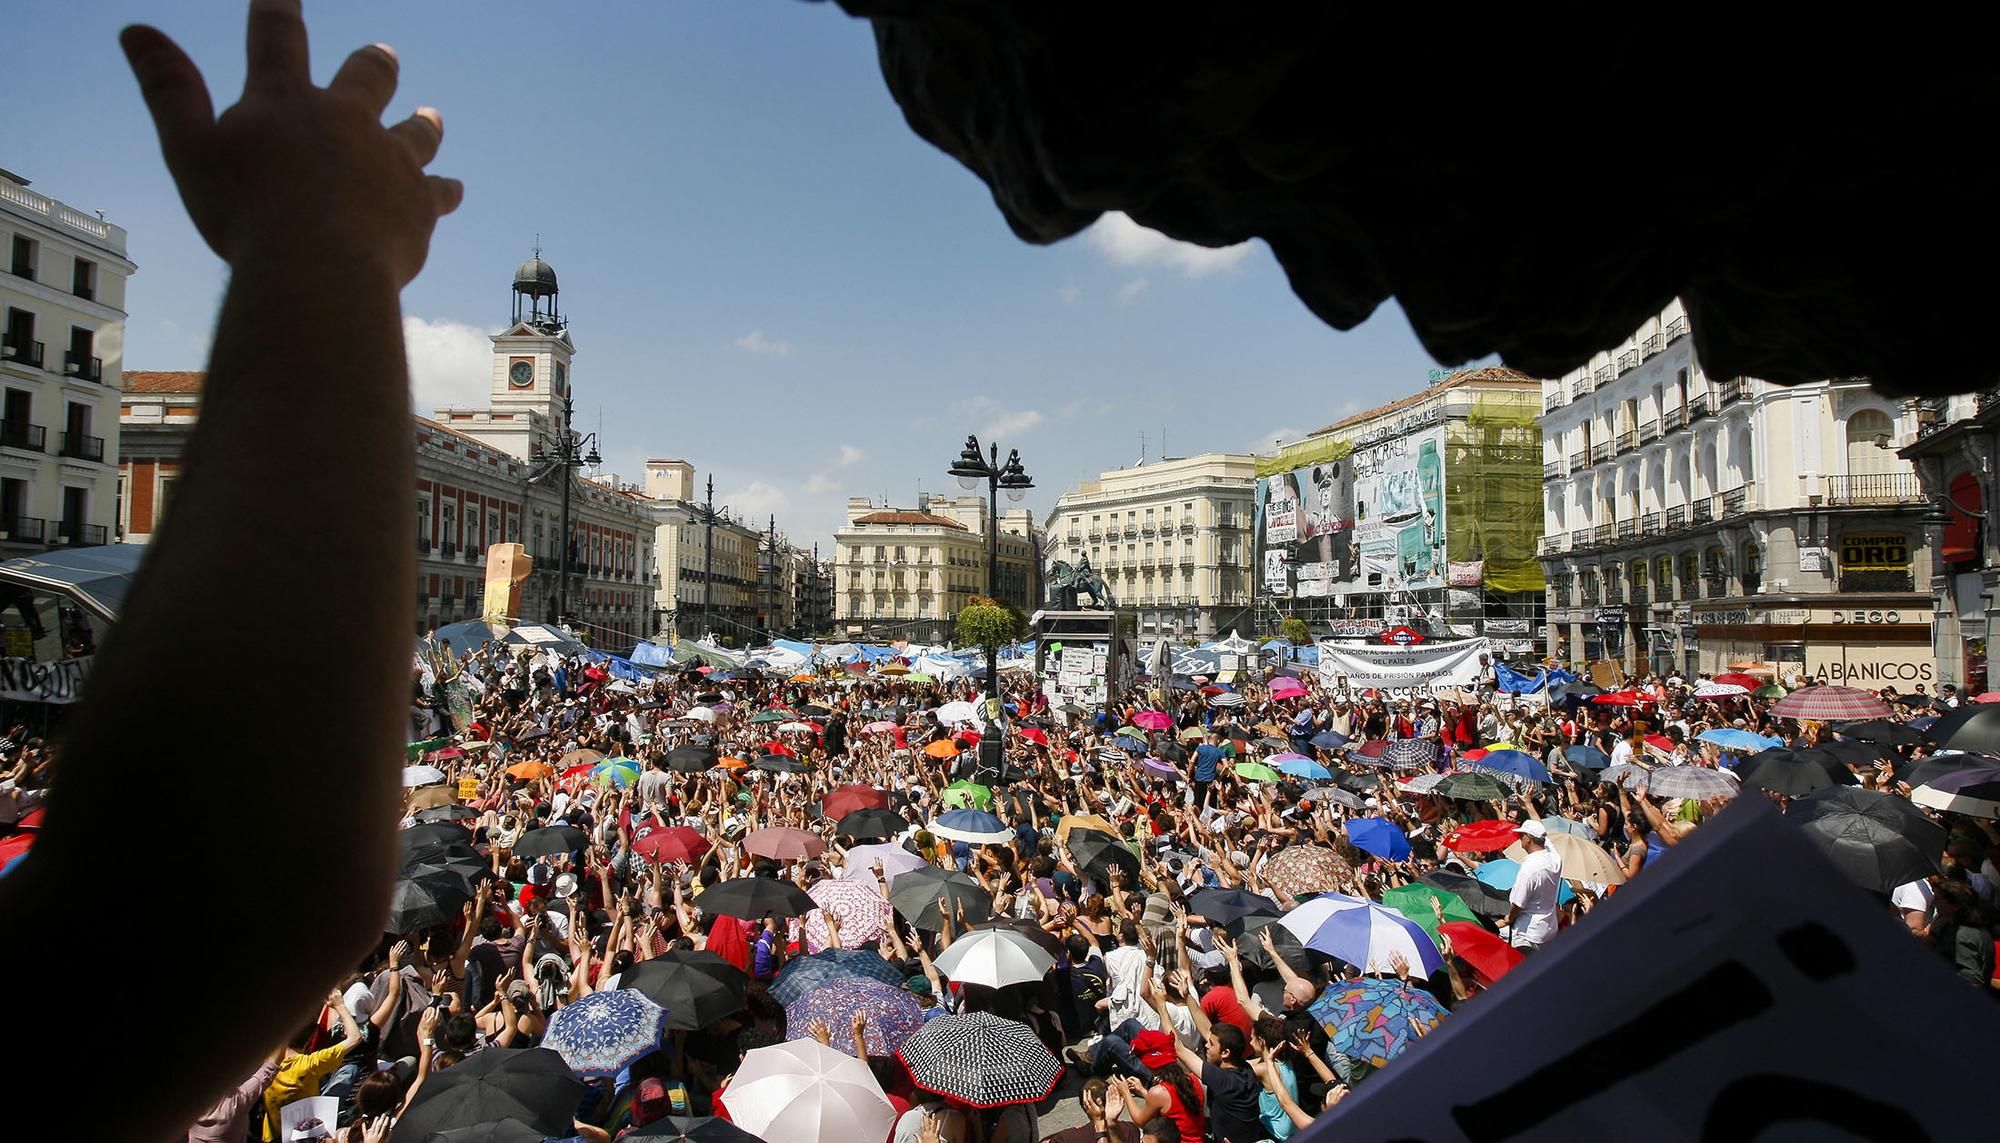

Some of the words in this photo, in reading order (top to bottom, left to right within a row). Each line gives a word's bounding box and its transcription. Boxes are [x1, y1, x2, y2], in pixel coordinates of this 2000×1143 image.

[1358, 459, 1384, 478] REAL
[1843, 536, 1906, 546] COMPRO
[1843, 546, 1906, 563] ORO
[1832, 609, 1901, 624] DIEGO
[1424, 645, 1470, 654] PROBLEMAS
[1781, 662, 1802, 679] DIEGO
[1816, 662, 1932, 680] ABANICOS
